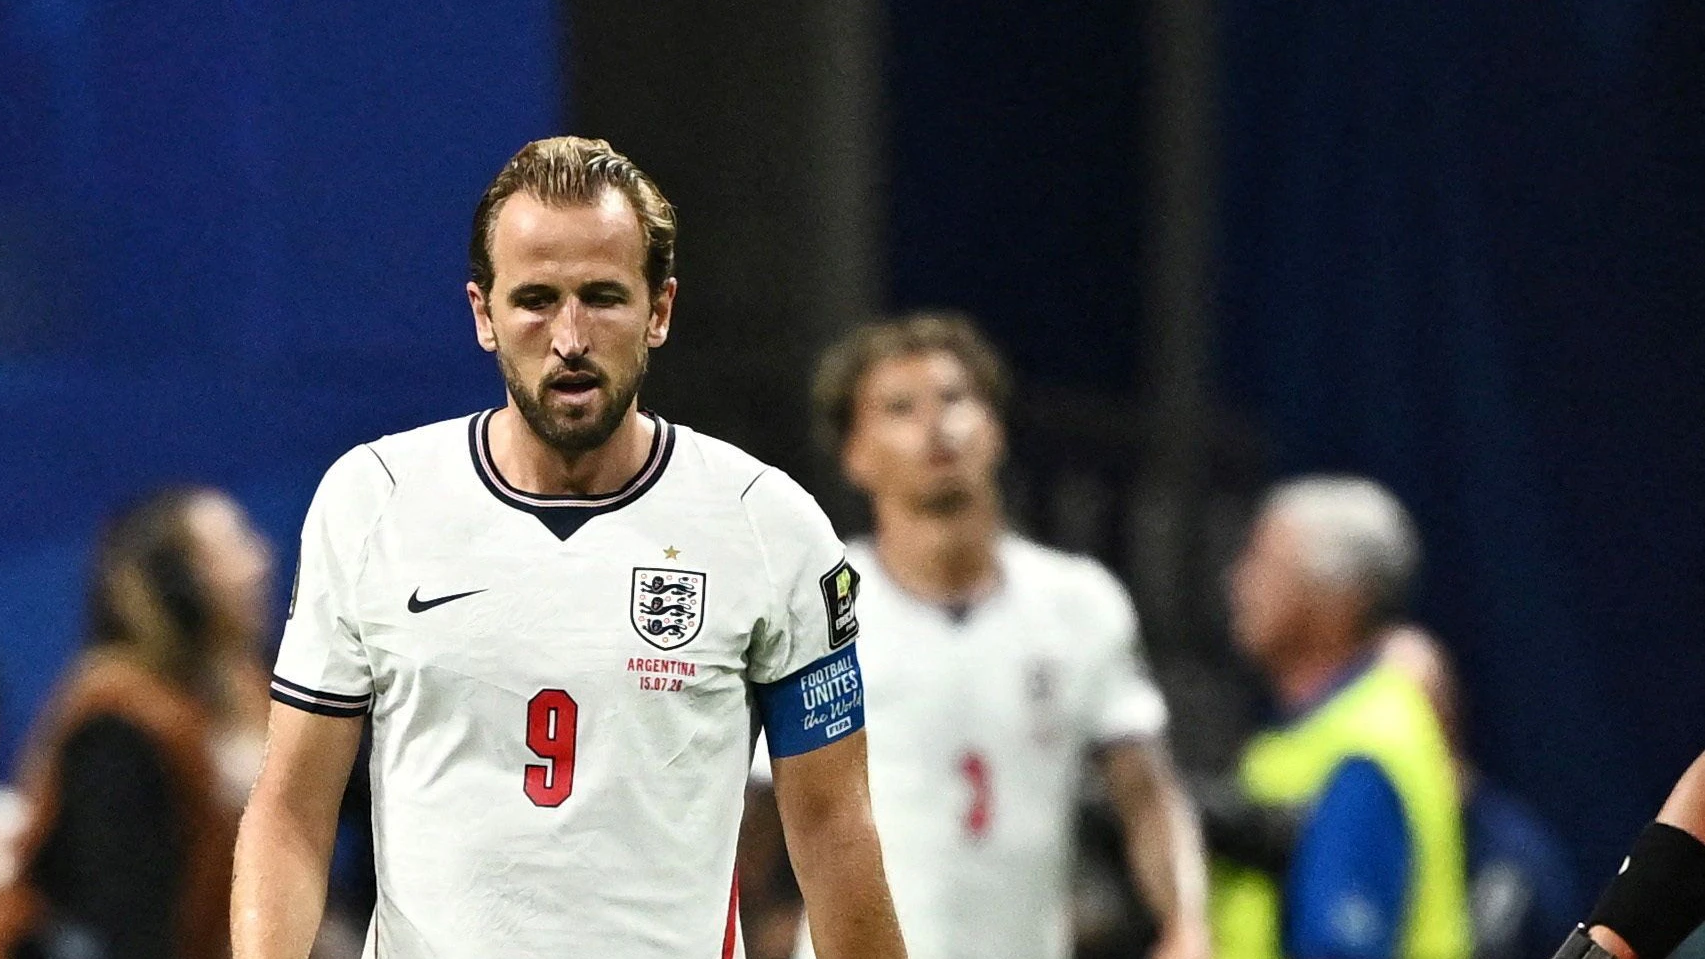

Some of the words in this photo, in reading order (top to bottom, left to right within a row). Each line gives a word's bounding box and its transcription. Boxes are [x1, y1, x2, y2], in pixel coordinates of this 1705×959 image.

[627, 657, 695, 676] ARGENTINA
[801, 655, 853, 691] FOOTBALL
[801, 709, 828, 730] the
[829, 689, 862, 719] World
[803, 669, 858, 710] UNITES
[523, 688, 578, 807] 9
